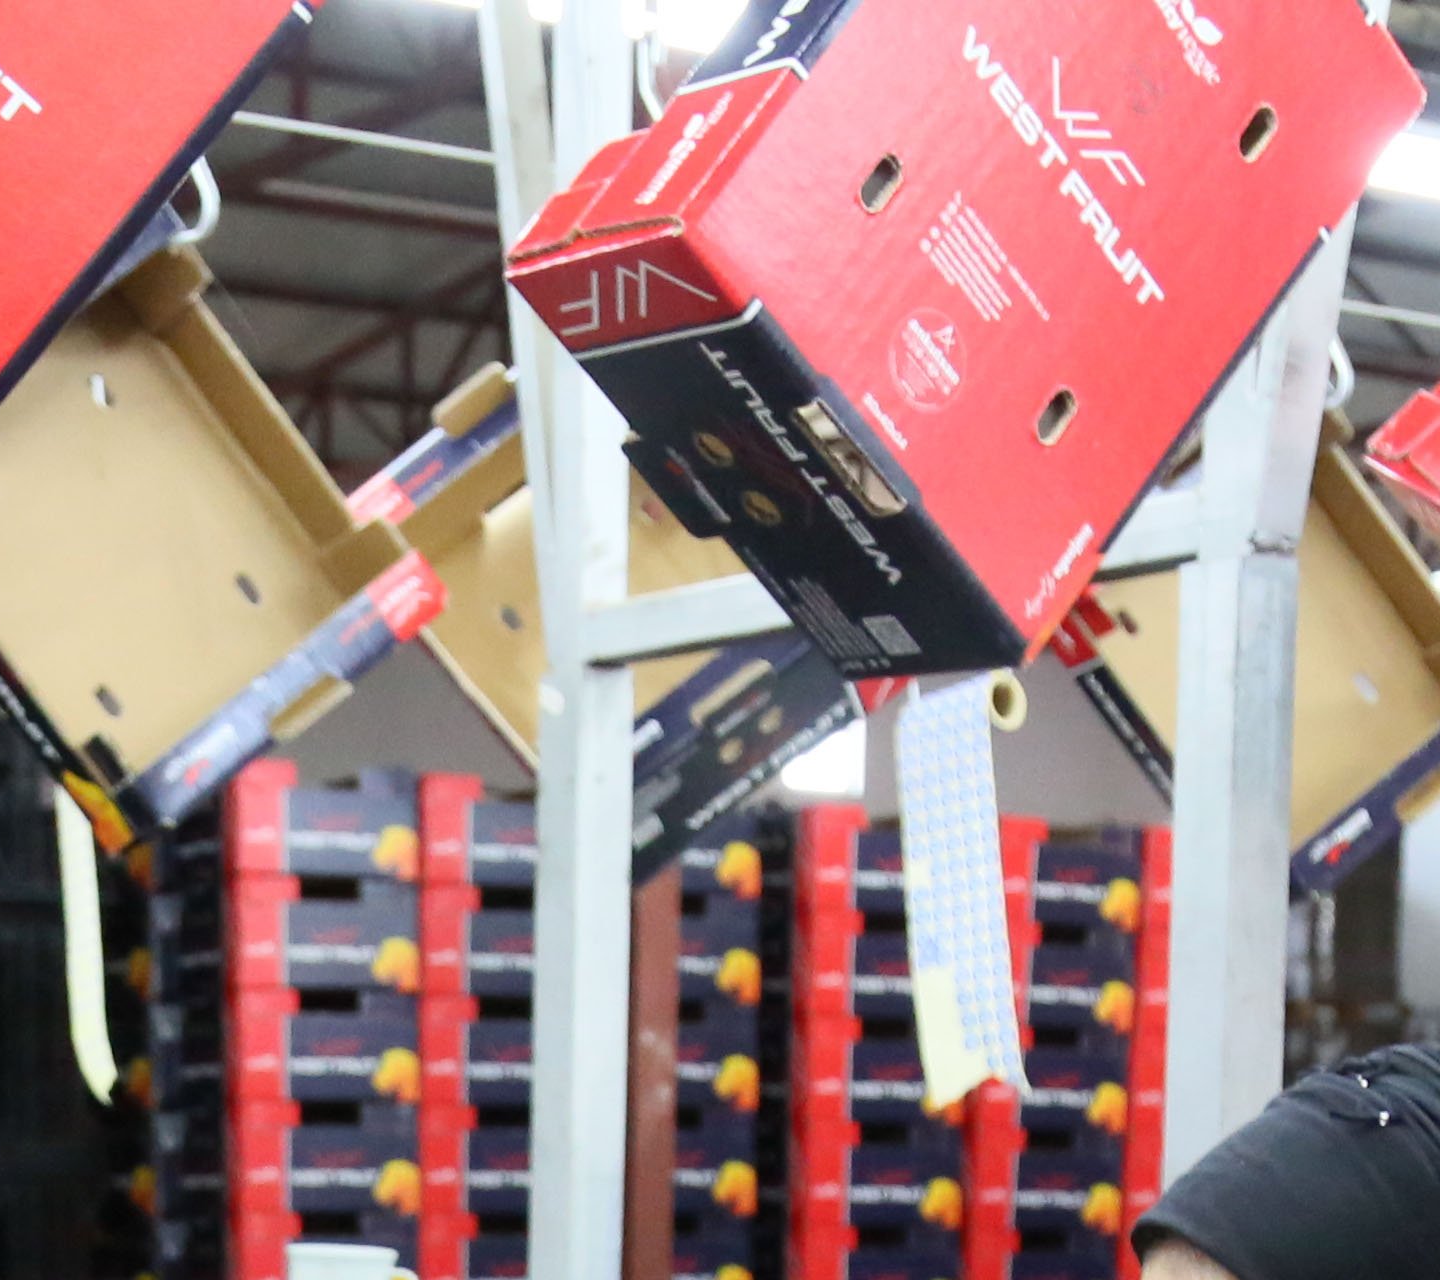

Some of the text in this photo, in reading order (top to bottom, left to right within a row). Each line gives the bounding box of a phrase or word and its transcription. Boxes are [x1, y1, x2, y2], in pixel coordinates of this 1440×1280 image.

[963, 24, 1069, 169] WEST
[1058, 168, 1165, 304] FRUIT
[1052, 55, 1145, 187] WF
[698, 341, 809, 463] FRUIT
[799, 466, 903, 587] WEST
